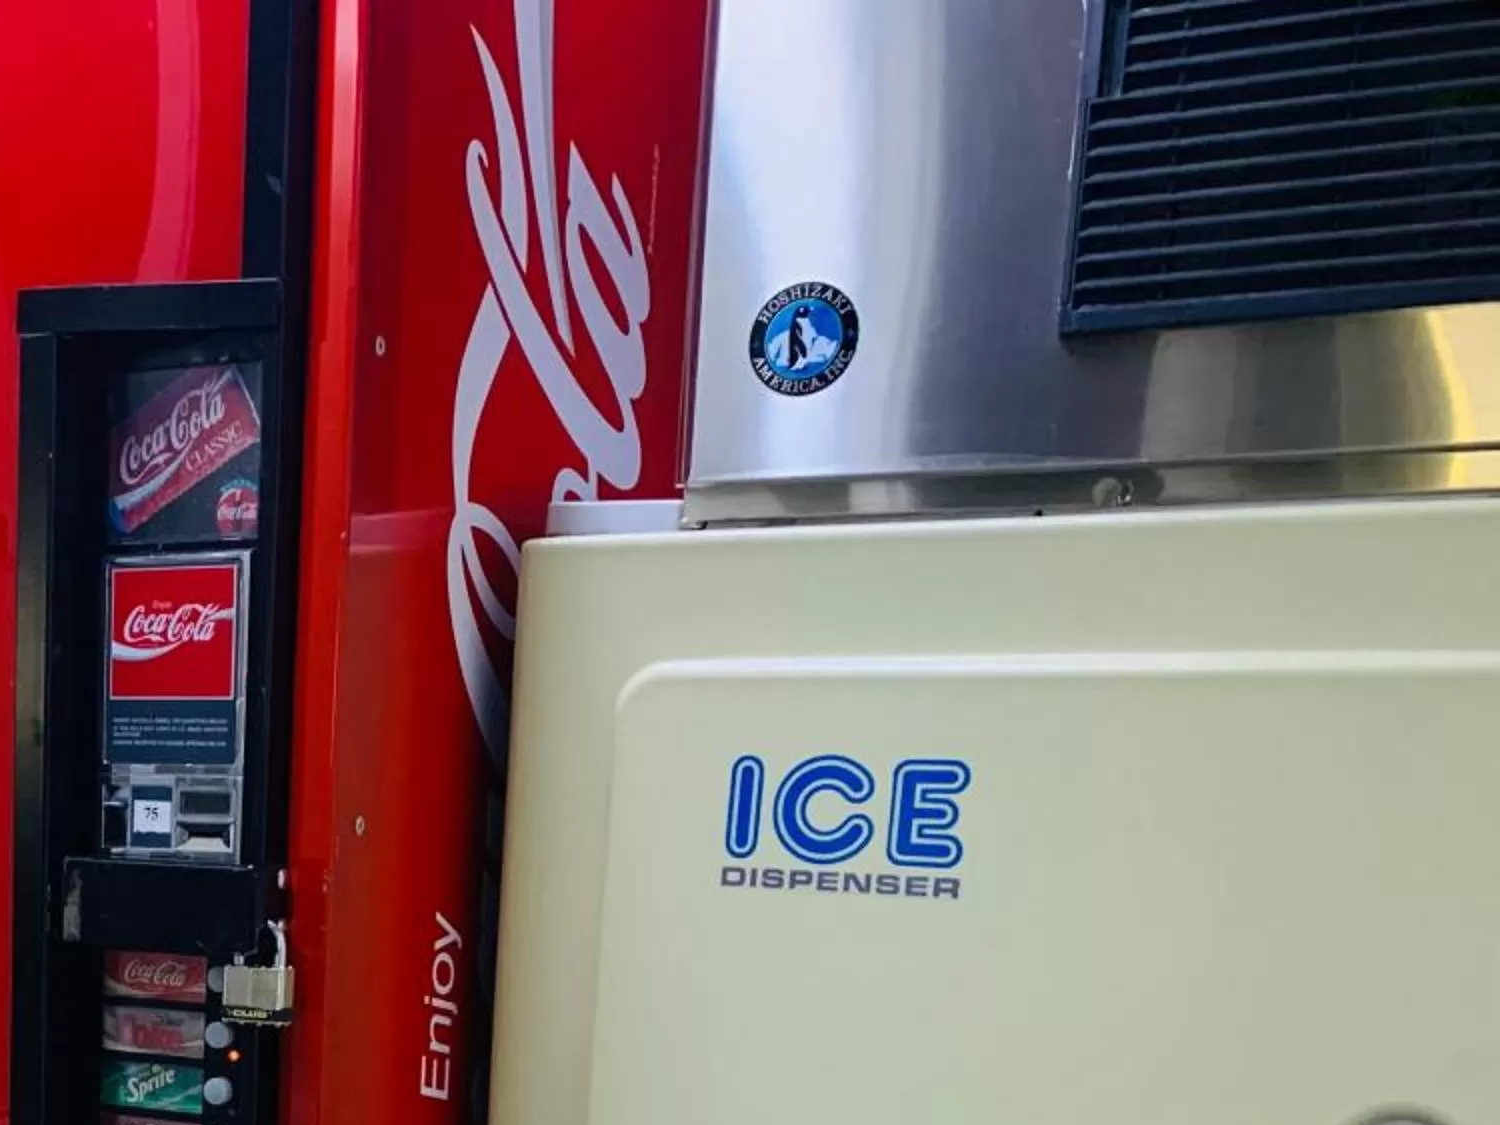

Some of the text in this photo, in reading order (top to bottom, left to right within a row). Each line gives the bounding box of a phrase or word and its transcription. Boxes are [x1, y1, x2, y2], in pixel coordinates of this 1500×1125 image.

[758, 284, 853, 323] HOSHIZAKI
[144, 807, 159, 821] 75
[725, 755, 971, 868] ICE
[720, 866, 961, 899] DISPENSER
[420, 911, 462, 1100] Enjoy
[127, 1064, 176, 1103] Sprite
